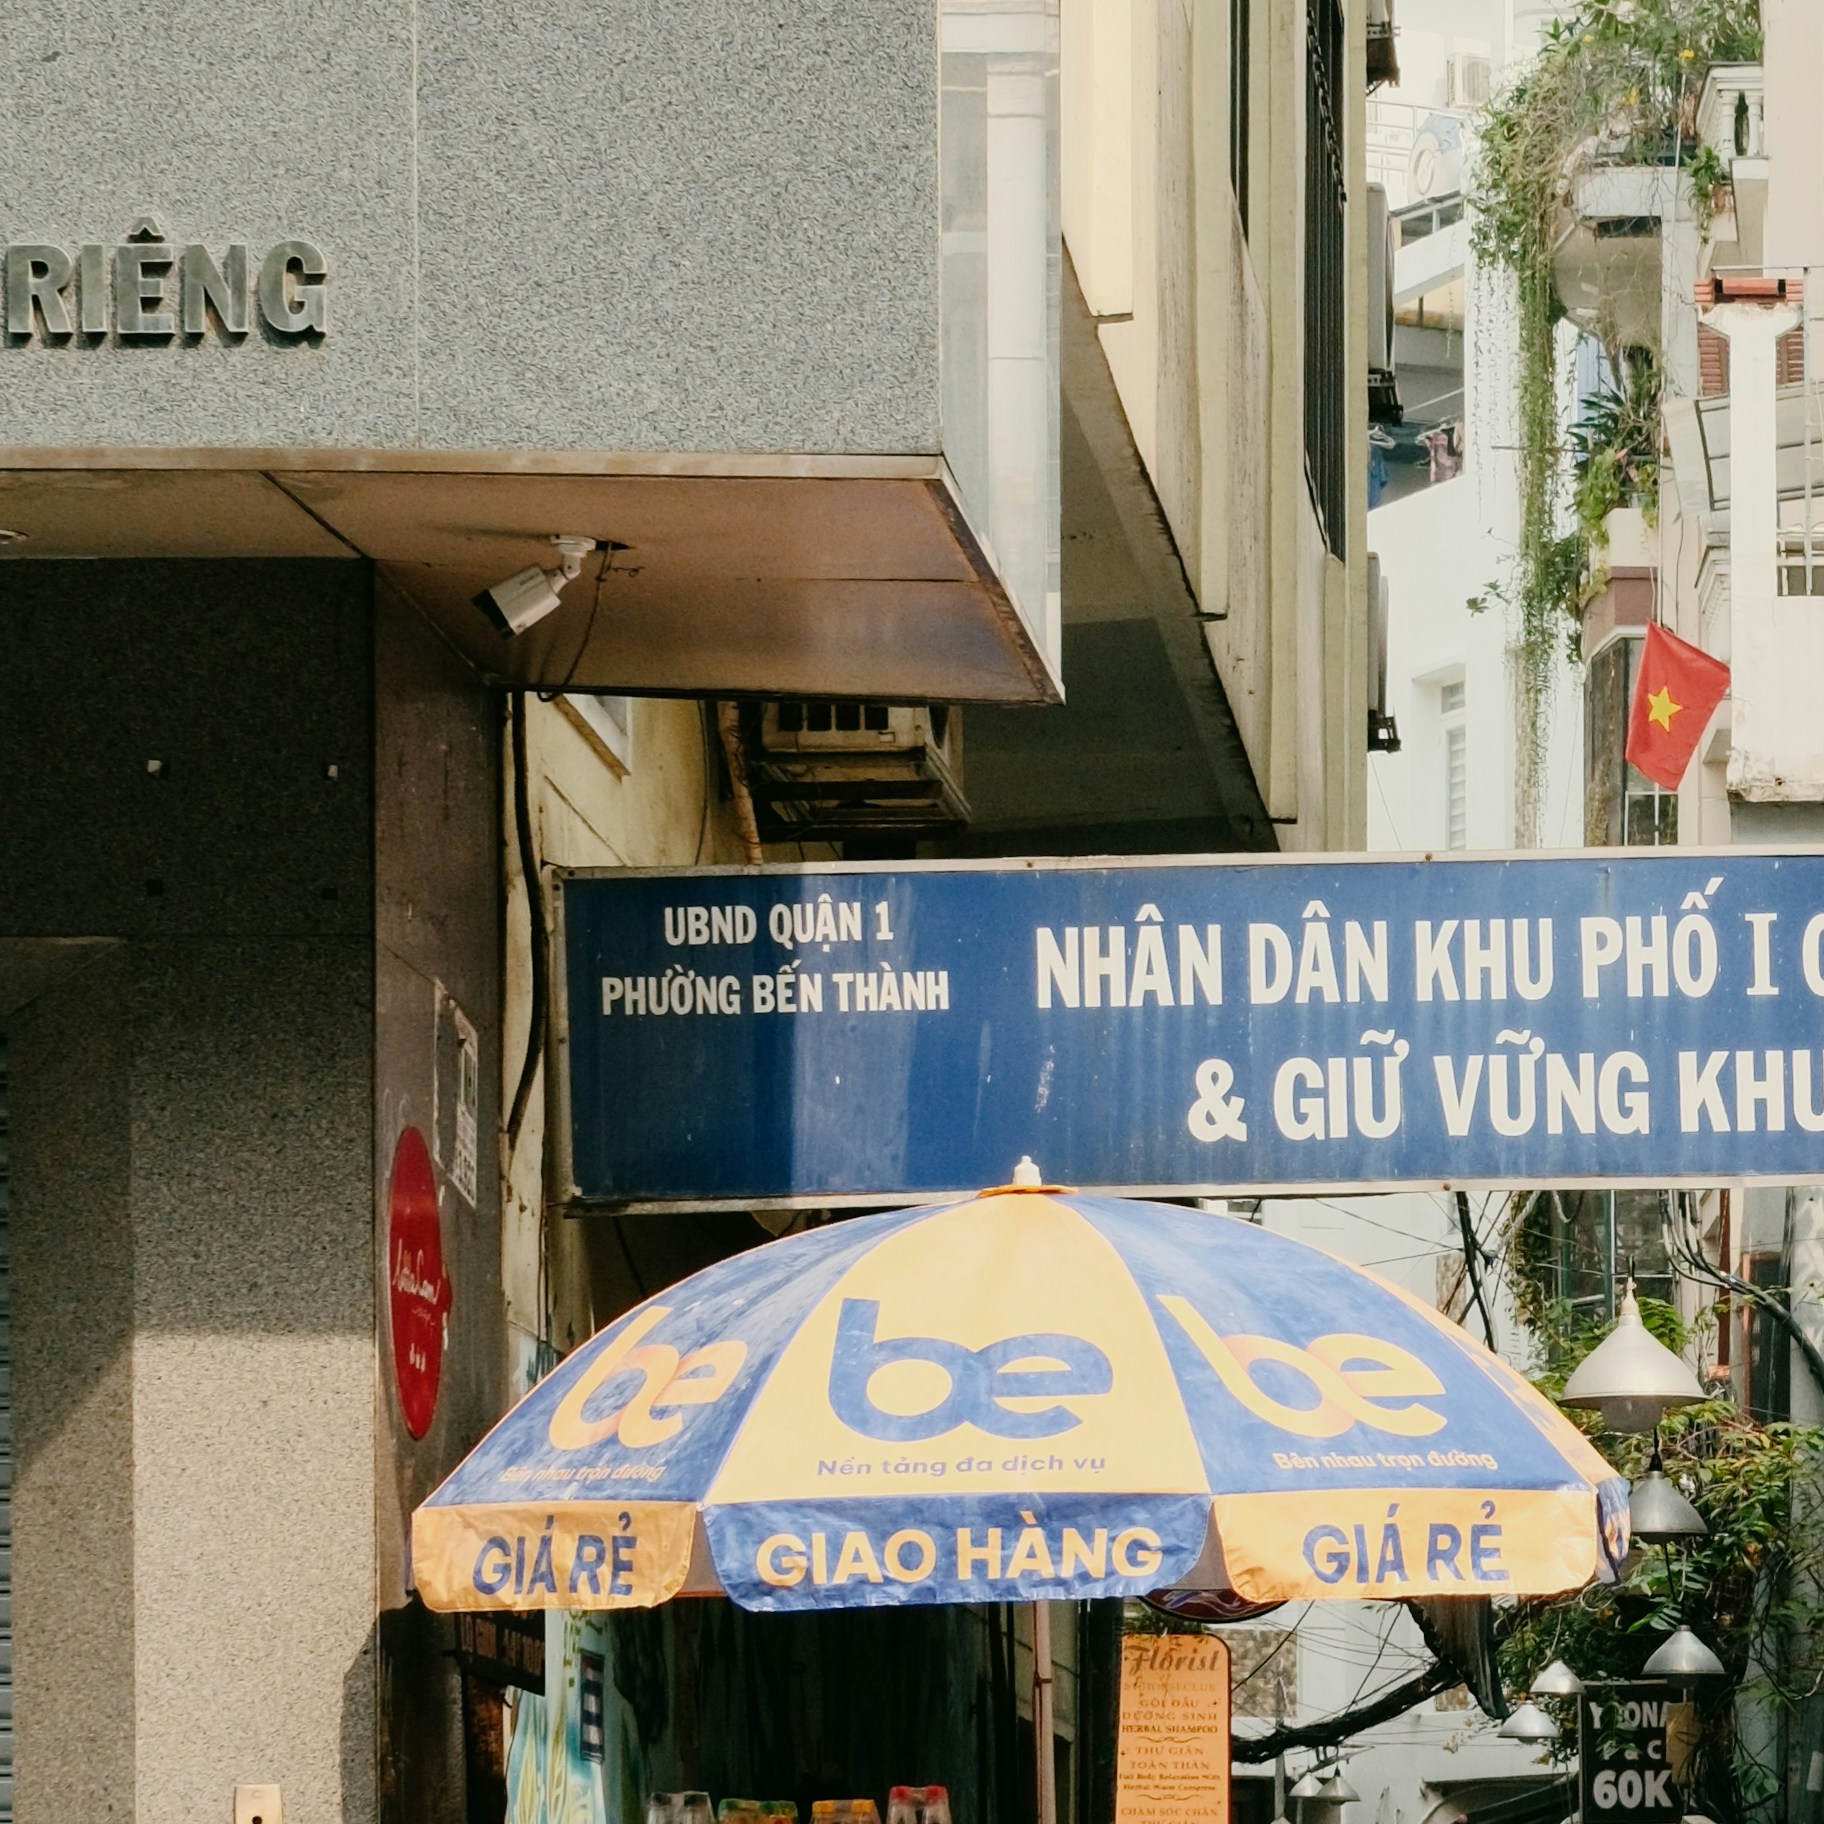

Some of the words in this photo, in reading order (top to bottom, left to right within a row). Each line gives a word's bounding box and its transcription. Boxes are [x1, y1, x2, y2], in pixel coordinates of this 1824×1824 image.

[7, 216, 328, 334] RIÊNG
[664, 903, 757, 948] UBND
[769, 892, 863, 955] QUẬN
[875, 901, 894, 942] 1
[1036, 902, 1220, 1010] NHÂN
[1250, 899, 1389, 1005] DÂN
[1416, 917, 1554, 1003] KHU
[1581, 876, 1720, 1000] PHỐ
[602, 967, 742, 1017] PHƯỜNG
[752, 959, 824, 1015] BẾN
[833, 961, 950, 1013] THÀNH
[1187, 1057, 1248, 1144] &
[1273, 1029, 1411, 1140] GIỮ
[1434, 1026, 1650, 1139] VỮNG
[827, 1296, 1113, 1440] be
[817, 1456, 872, 1476] Nền
[882, 1456, 947, 1476] tảng
[955, 1456, 993, 1472] đa
[1001, 1454, 1063, 1475] dịch
[1073, 1457, 1106, 1475] vụ
[1272, 1452, 1320, 1470] Bên
[1320, 1451, 1377, 1468] nhau
[1377, 1451, 1426, 1472] trọn
[473, 1514, 558, 1596] GIÁ
[569, 1511, 637, 1596] RẺ
[755, 1527, 938, 1588] GIAO
[956, 1509, 1163, 1582] HÀNG
[1302, 1502, 1411, 1585] GIÁ
[1426, 1499, 1511, 1582] RẺ
[1593, 1769, 1673, 1809] 60K
